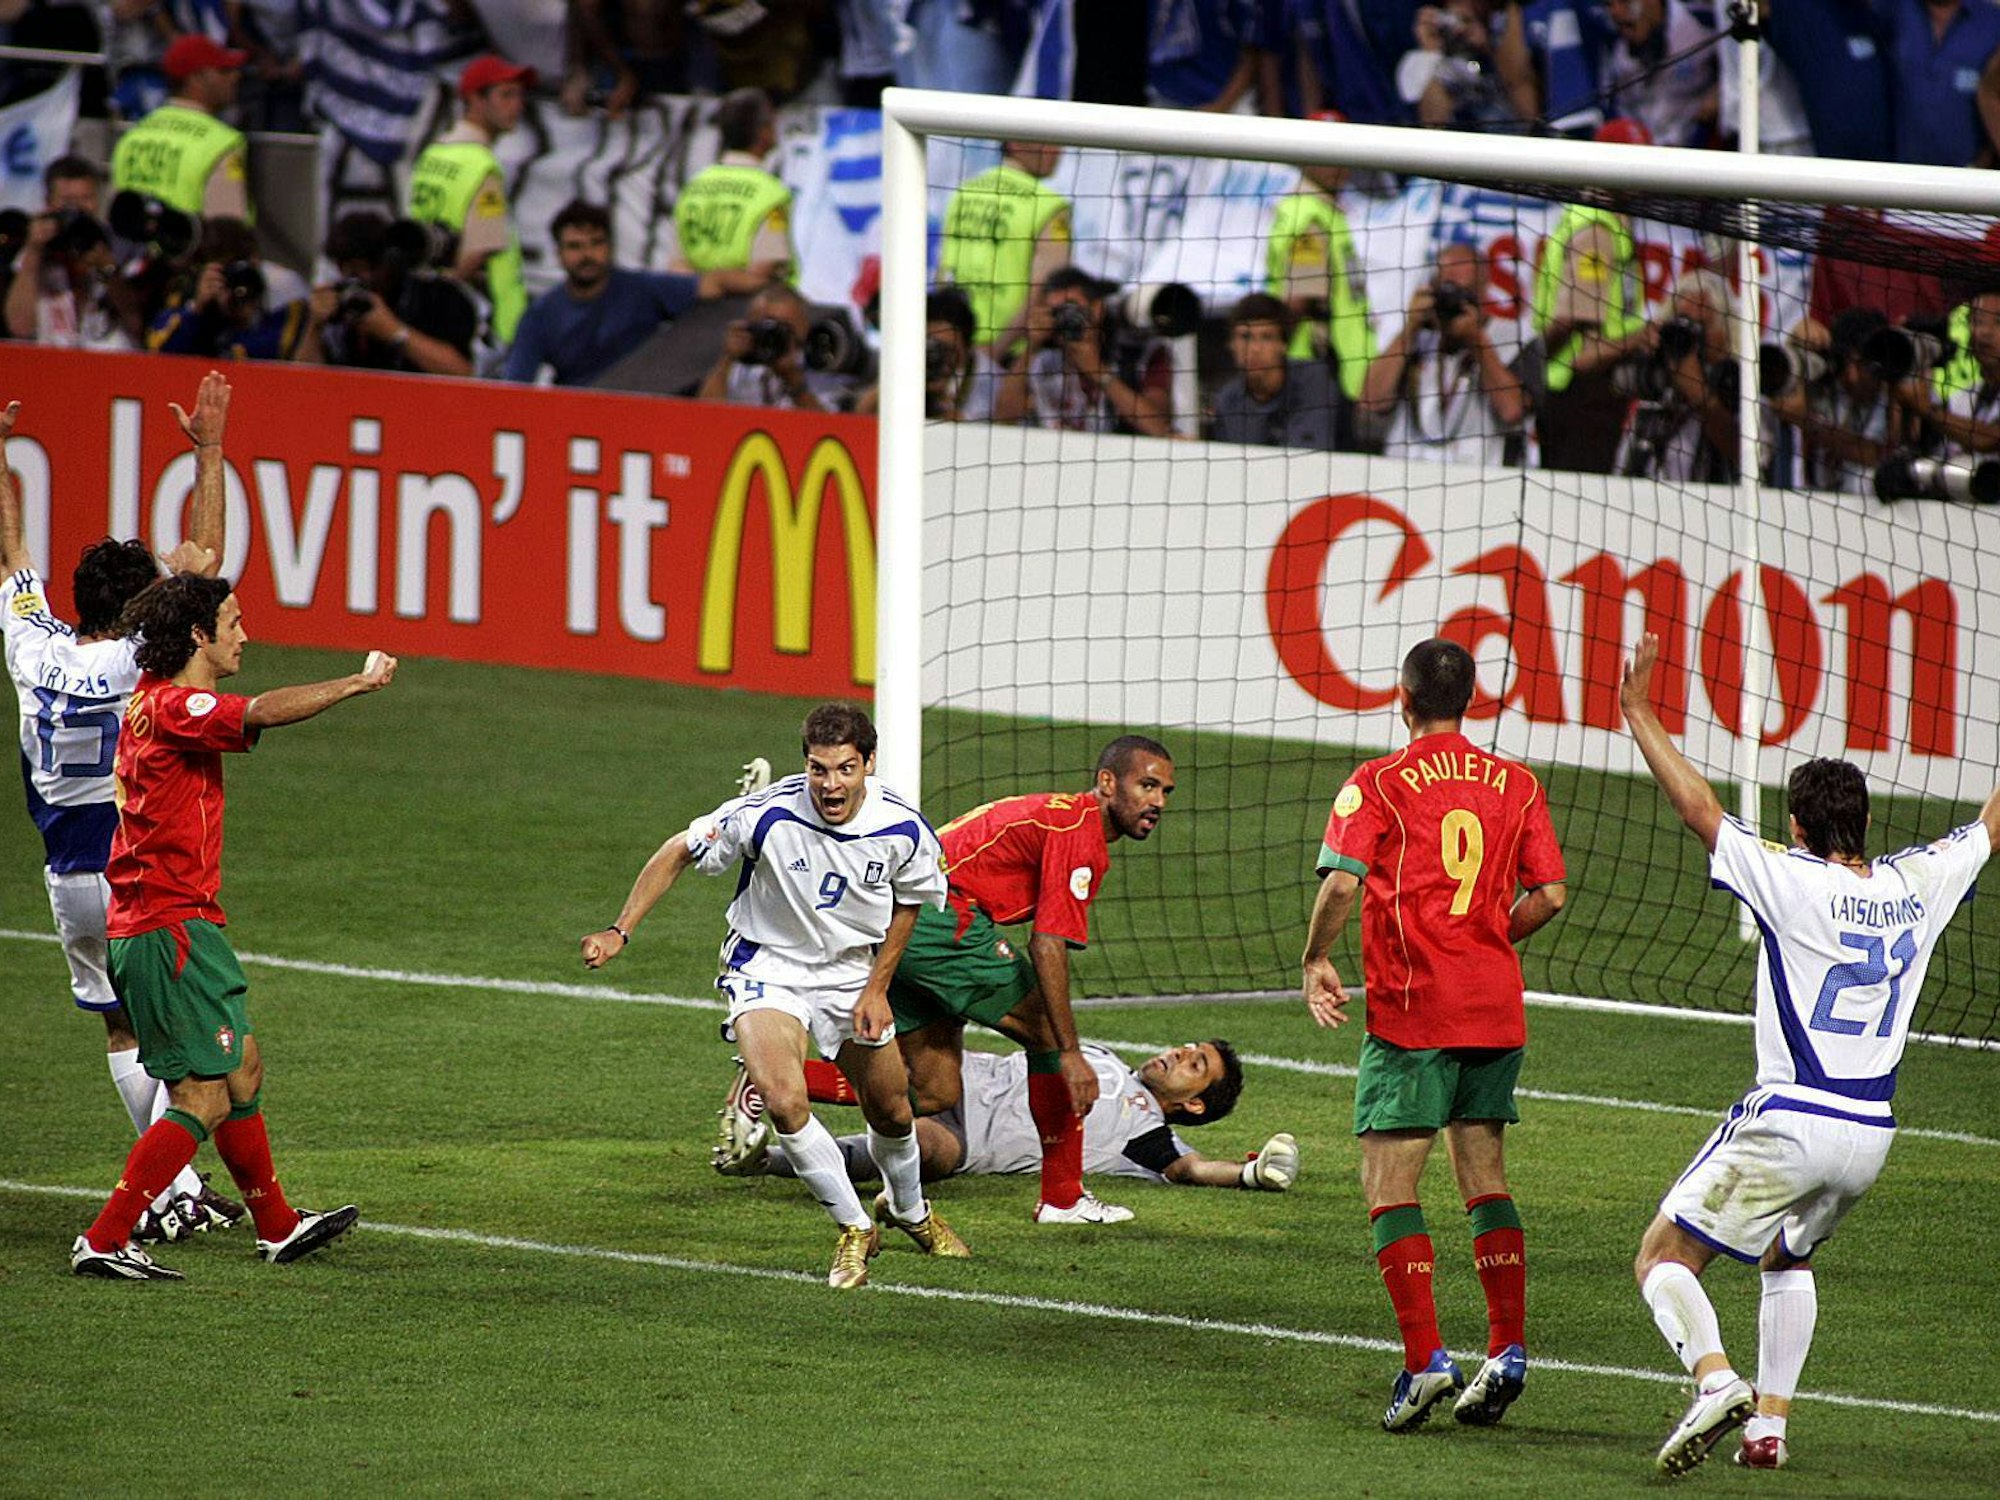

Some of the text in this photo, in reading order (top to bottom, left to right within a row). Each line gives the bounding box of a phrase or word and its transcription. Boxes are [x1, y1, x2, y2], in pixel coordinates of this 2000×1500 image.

[110, 399, 525, 624] lovin'
[566, 437, 669, 641] it
[1265, 492, 1959, 758] Canon
[32, 686, 121, 778] 15
[1399, 751, 1509, 795] PAULETA
[815, 871, 849, 911] 9
[1441, 808, 1484, 915] 9
[1809, 929, 1918, 1037] 21
